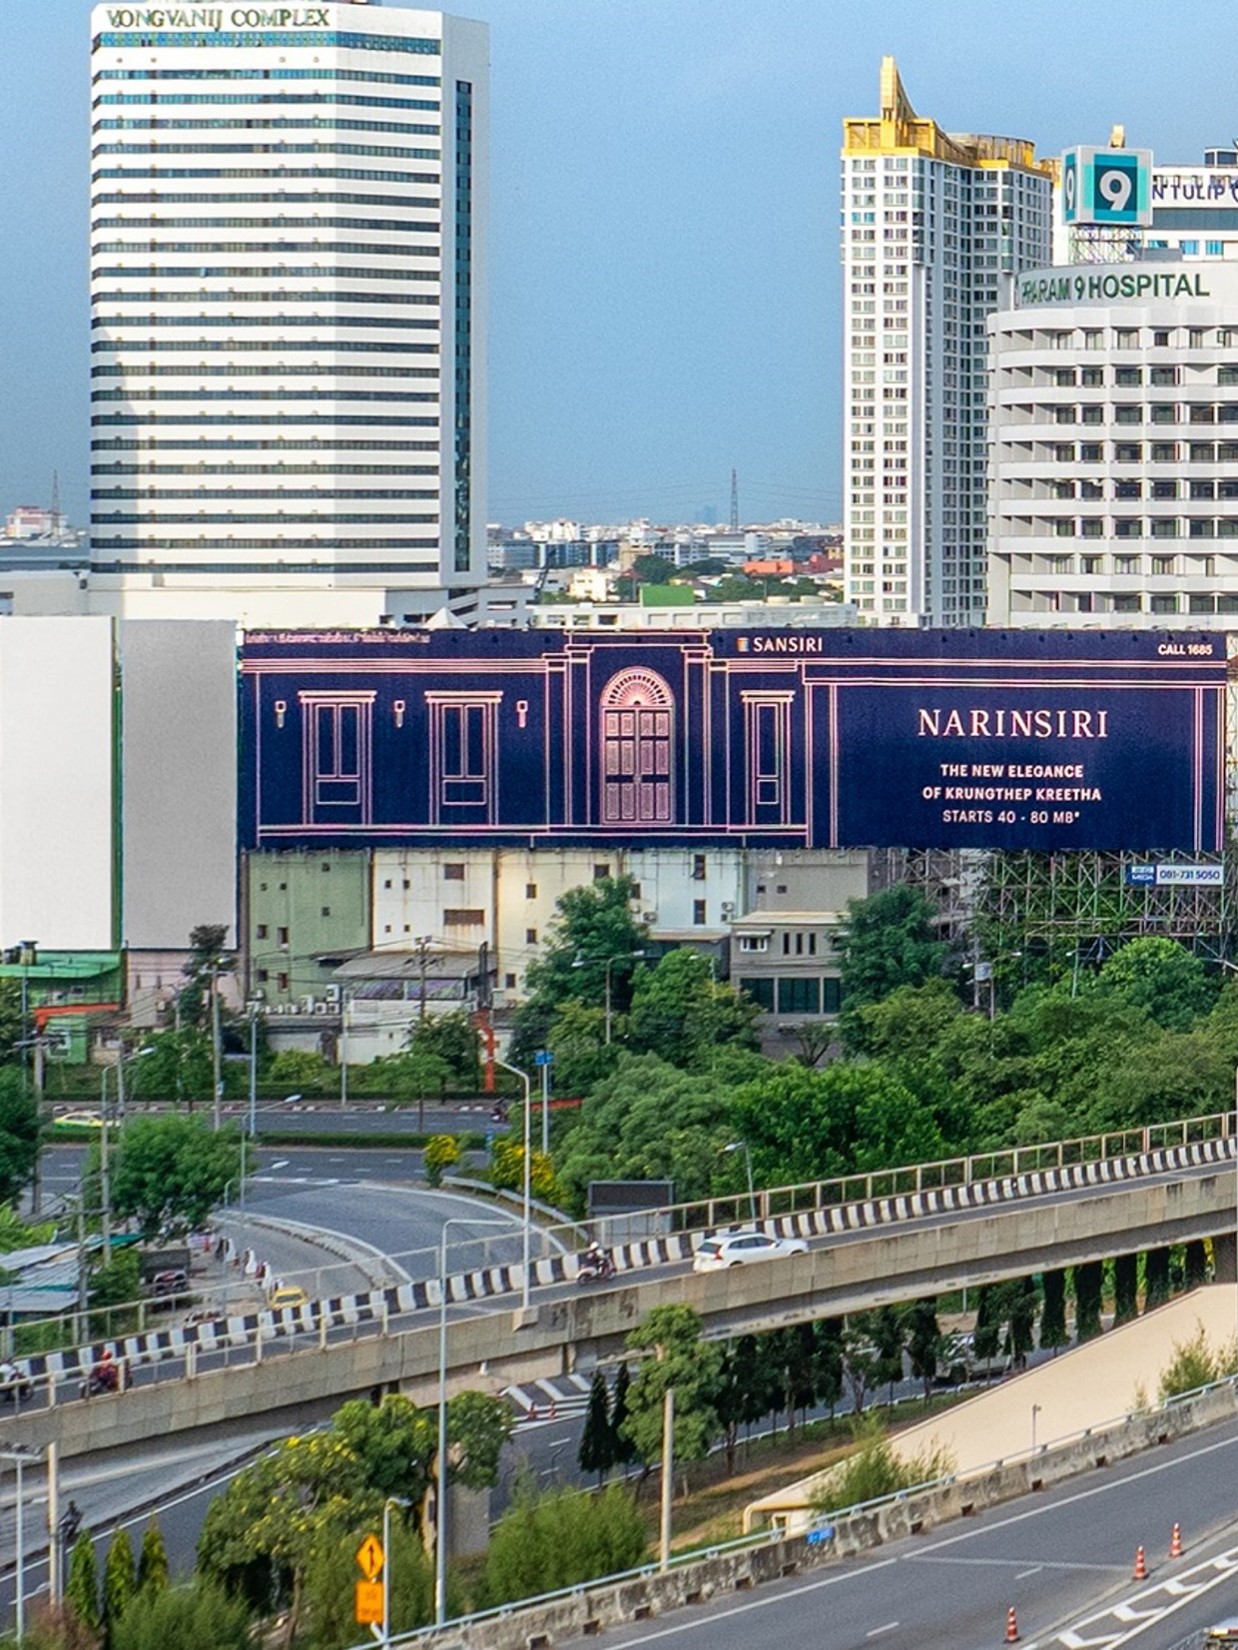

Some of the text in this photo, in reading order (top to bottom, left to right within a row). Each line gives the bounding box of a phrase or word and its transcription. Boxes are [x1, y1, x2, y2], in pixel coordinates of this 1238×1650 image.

[106, 9, 330, 31] VONGVANIJ COMPLEX
[1100, 169, 1132, 212] 9
[1172, 184, 1226, 201] TULIP
[1074, 276, 1086, 300] 9
[1088, 273, 1210, 299] HOSPITAL
[753, 636, 823, 652] SANSIRI
[1157, 643, 1213, 656] CALL 1685
[917, 708, 1110, 738] NARINSIRI
[940, 763, 1084, 778] THE NEW ELEGANCE
[922, 786, 1102, 801] OF KRUNGTHEP KREETHA
[942, 809, 994, 824] STARTS
[997, 810, 1016, 824] 40
[1029, 811, 1049, 825] 80
